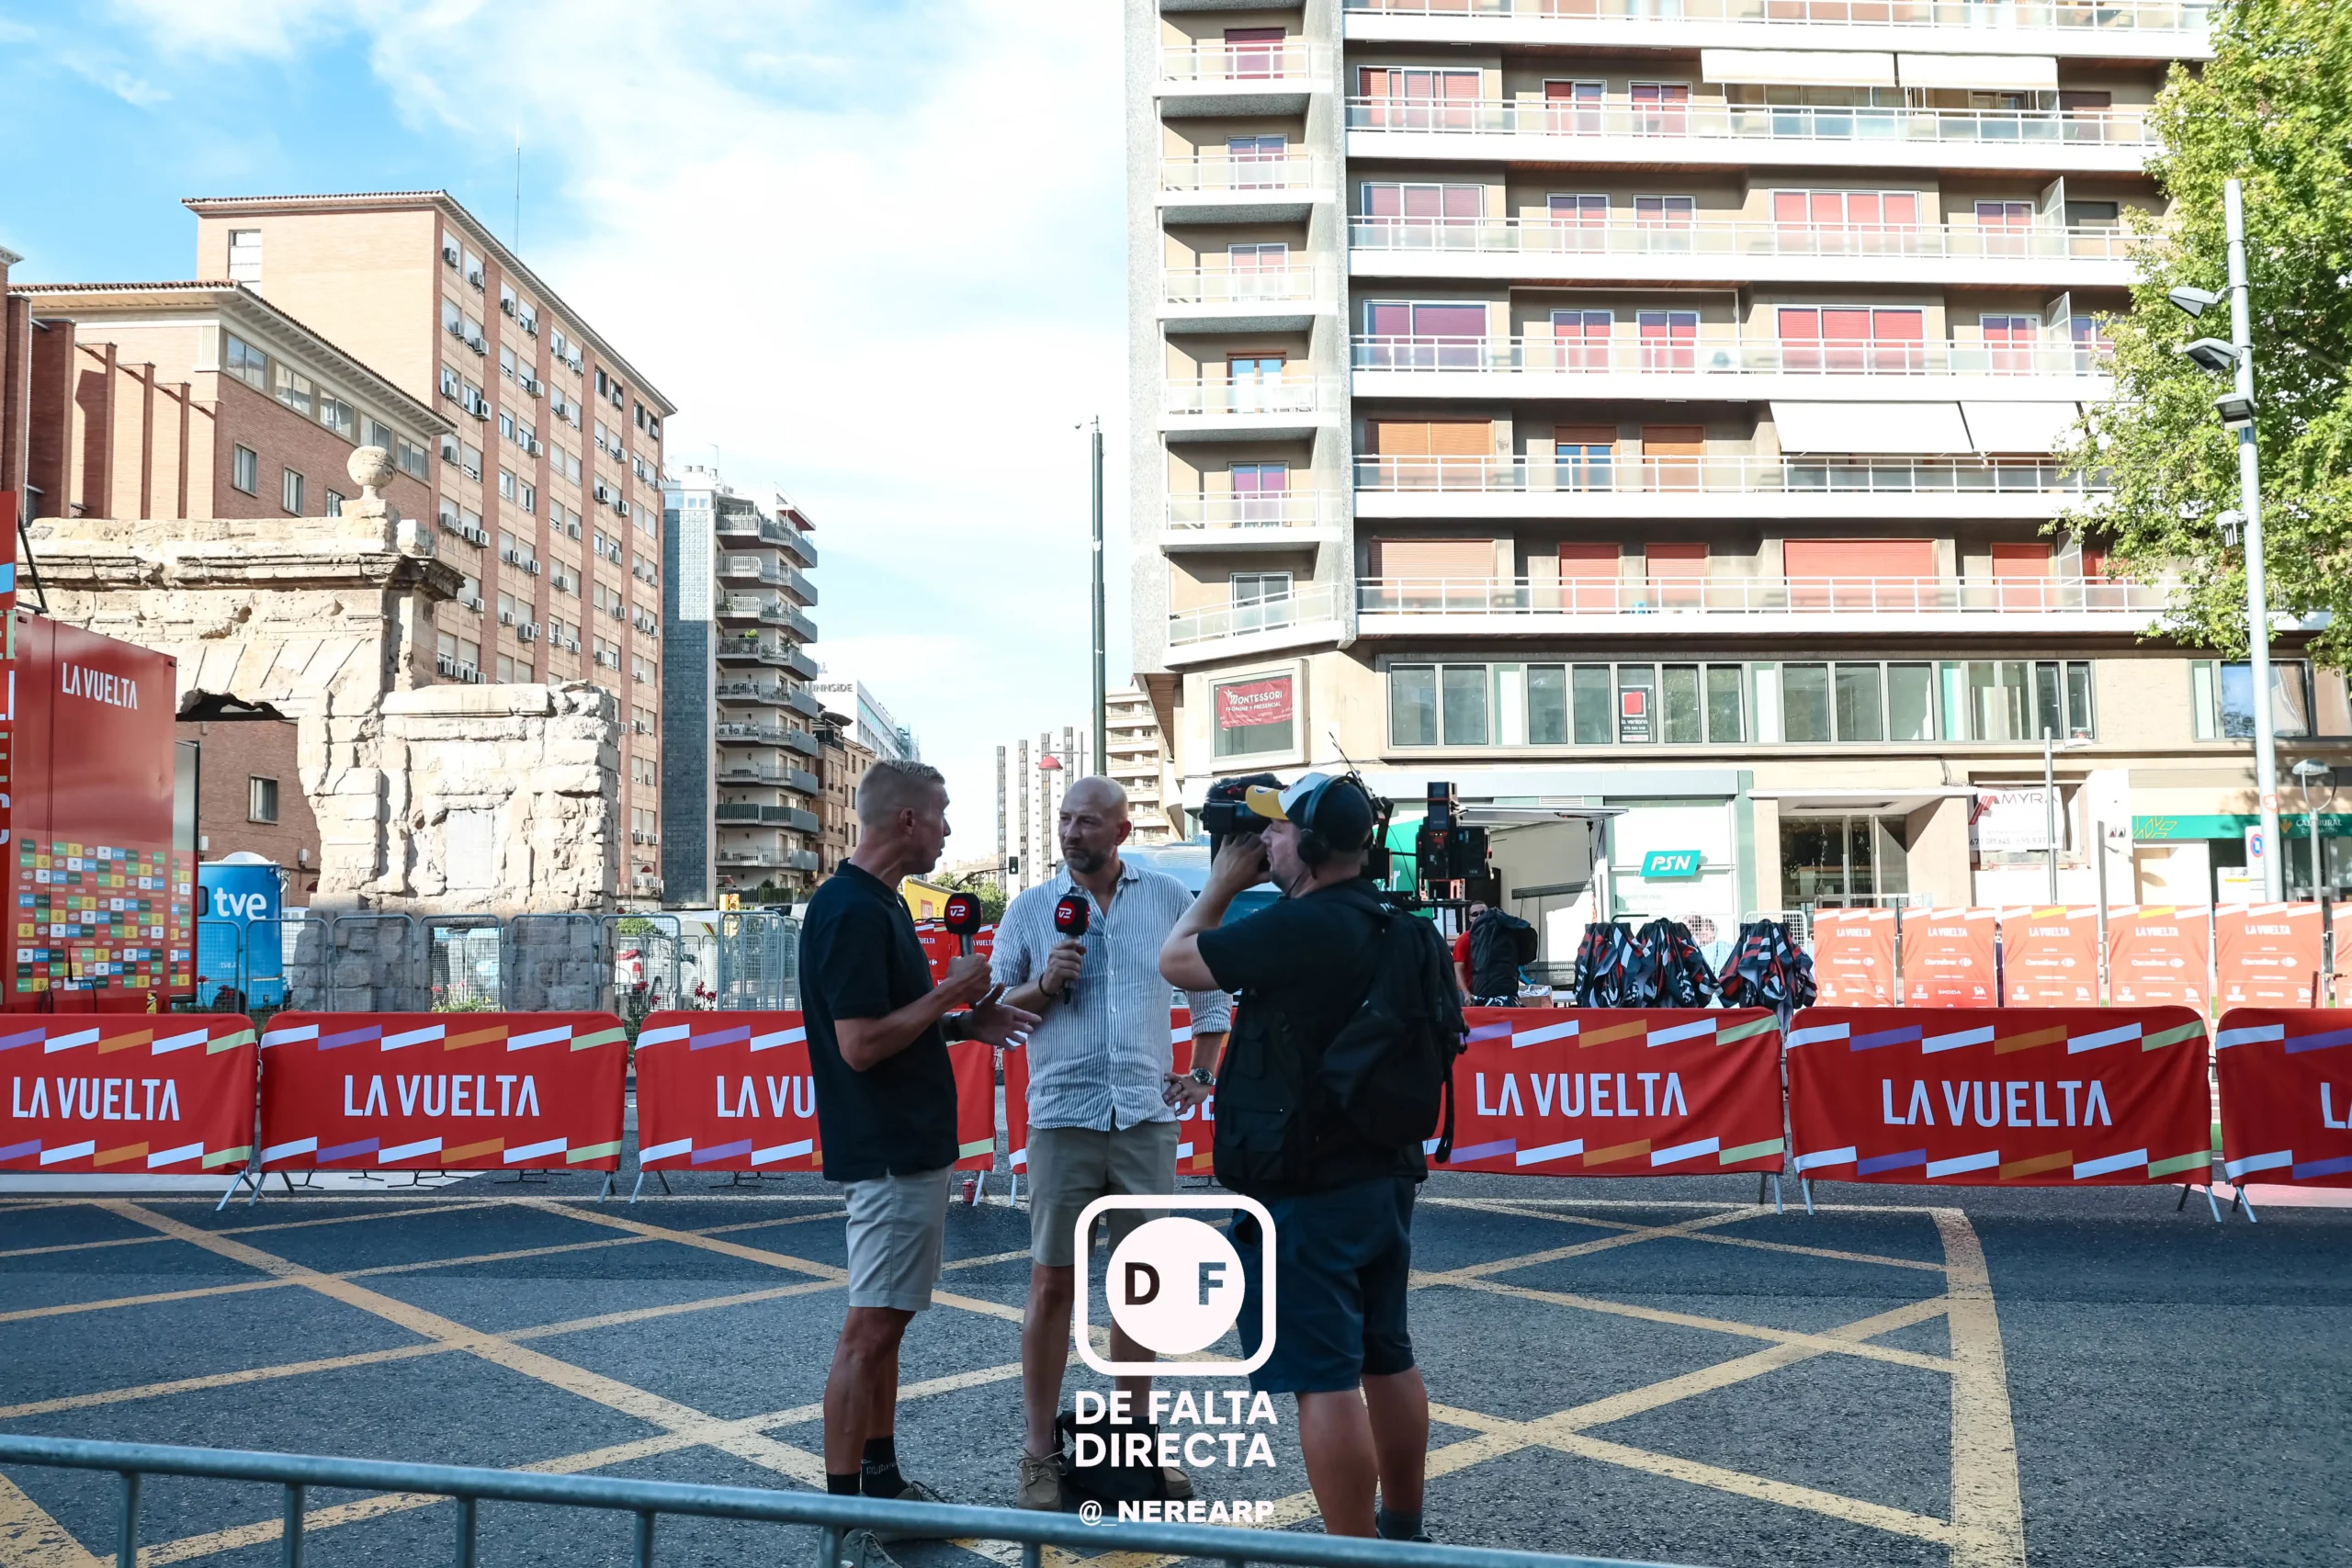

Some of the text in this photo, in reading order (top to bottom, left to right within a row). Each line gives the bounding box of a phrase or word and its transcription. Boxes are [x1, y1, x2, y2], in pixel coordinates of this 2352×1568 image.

[62, 662, 138, 710] LA VUELTA
[1230, 691, 1283, 705] MONTESSORI
[1651, 855, 1691, 872] PSN
[215, 887, 266, 920] tve
[1836, 928, 1845, 938] LA
[1928, 927, 1937, 938] LA
[2029, 927, 2039, 937] LA
[2135, 926, 2146, 937] LA
[2245, 924, 2256, 935] LA
[13, 1077, 180, 1121] LA VUELTA
[345, 1075, 540, 1116] LA VUELTA
[717, 1076, 760, 1117] LA
[1476, 1073, 1688, 1117] LA VUELTA
[1883, 1079, 2111, 1127] LA VUELTA
[2321, 1082, 2352, 1129] L
